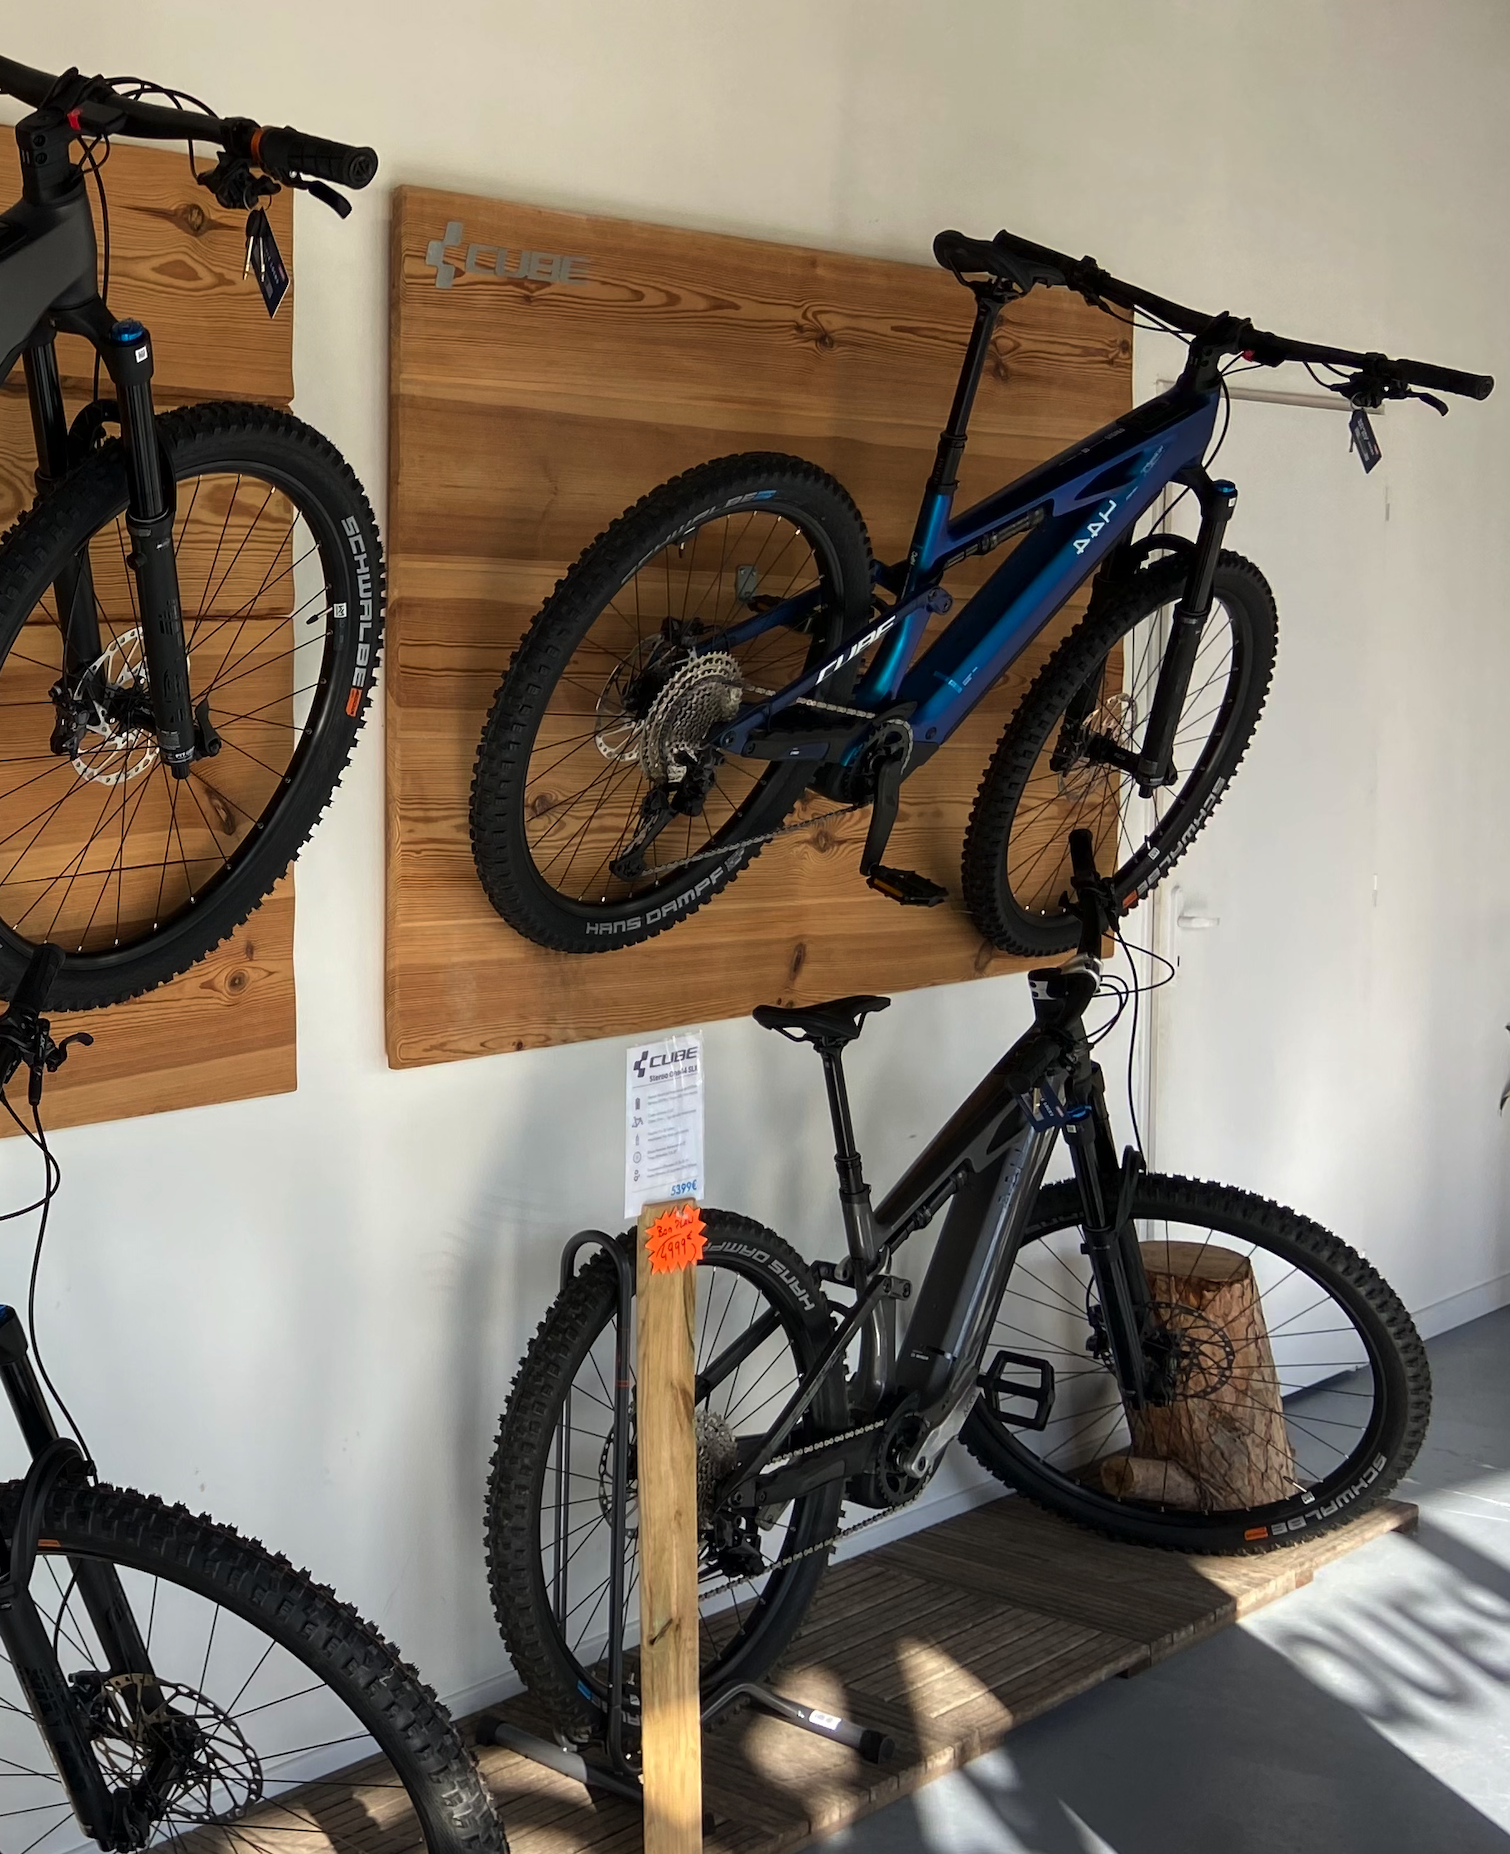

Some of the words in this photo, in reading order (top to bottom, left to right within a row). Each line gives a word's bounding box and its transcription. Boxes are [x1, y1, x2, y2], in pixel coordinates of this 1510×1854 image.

[465, 244, 591, 285] CUBE
[341, 515, 372, 688] SCHWALBE
[586, 916, 642, 935] HANS
[646, 866, 724, 925] DAMPF
[649, 1046, 698, 1068] CUBE
[671, 1179, 697, 1196] 5399€
[768, 1259, 815, 1311] HANS
[1271, 1452, 1387, 1536] SCHWALBE
